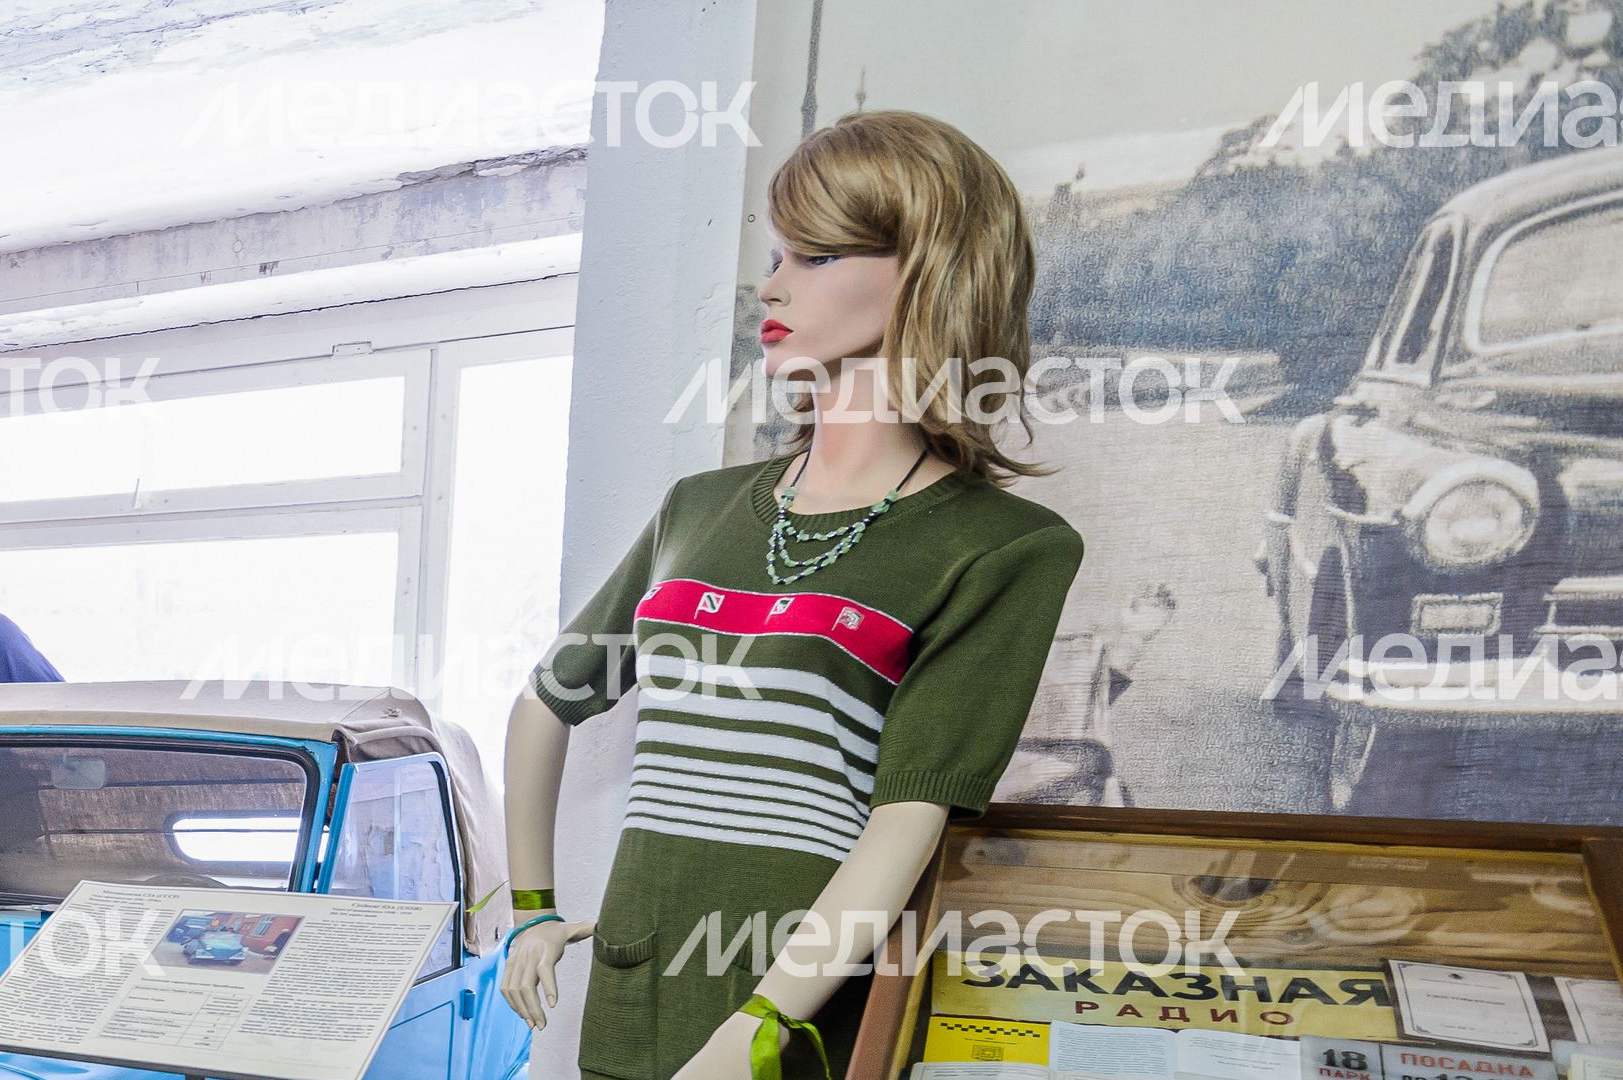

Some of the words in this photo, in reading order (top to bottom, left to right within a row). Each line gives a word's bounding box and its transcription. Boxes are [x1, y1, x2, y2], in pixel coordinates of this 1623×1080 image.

[961, 959, 1392, 1007] ЗАКАЗНАЯ
[1074, 1000, 1296, 1026] РАДИО
[1323, 1048, 1369, 1071] 18
[1400, 1053, 1535, 1078] ПОСАДКА
